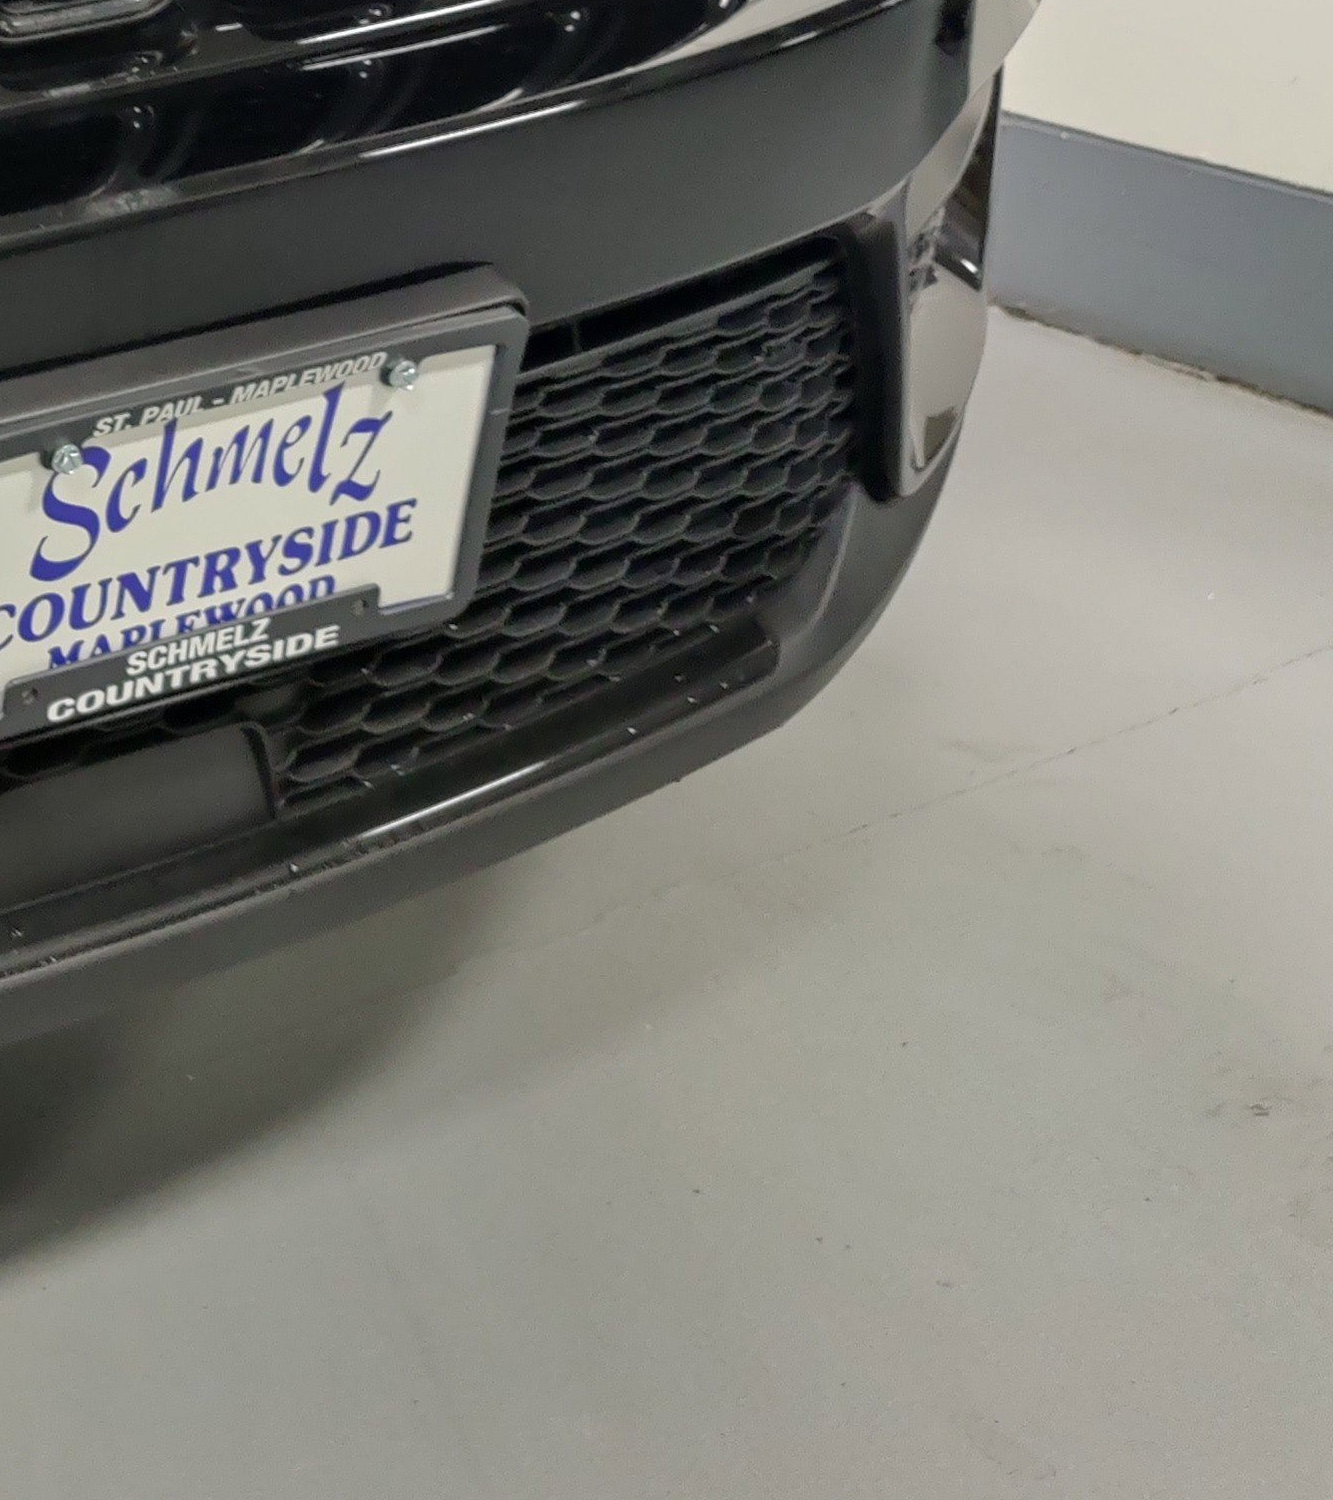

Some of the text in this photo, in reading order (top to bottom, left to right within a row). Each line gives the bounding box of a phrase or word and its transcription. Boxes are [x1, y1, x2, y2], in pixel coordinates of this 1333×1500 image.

[94, 412, 133, 438] ST.
[140, 397, 205, 426] PAUL
[230, 352, 388, 405] MAPLEWOOD
[30, 385, 393, 581] Schmelz
[47, 625, 341, 722] COUNTRYSIDE
[126, 618, 271, 676] SCHMELZ
